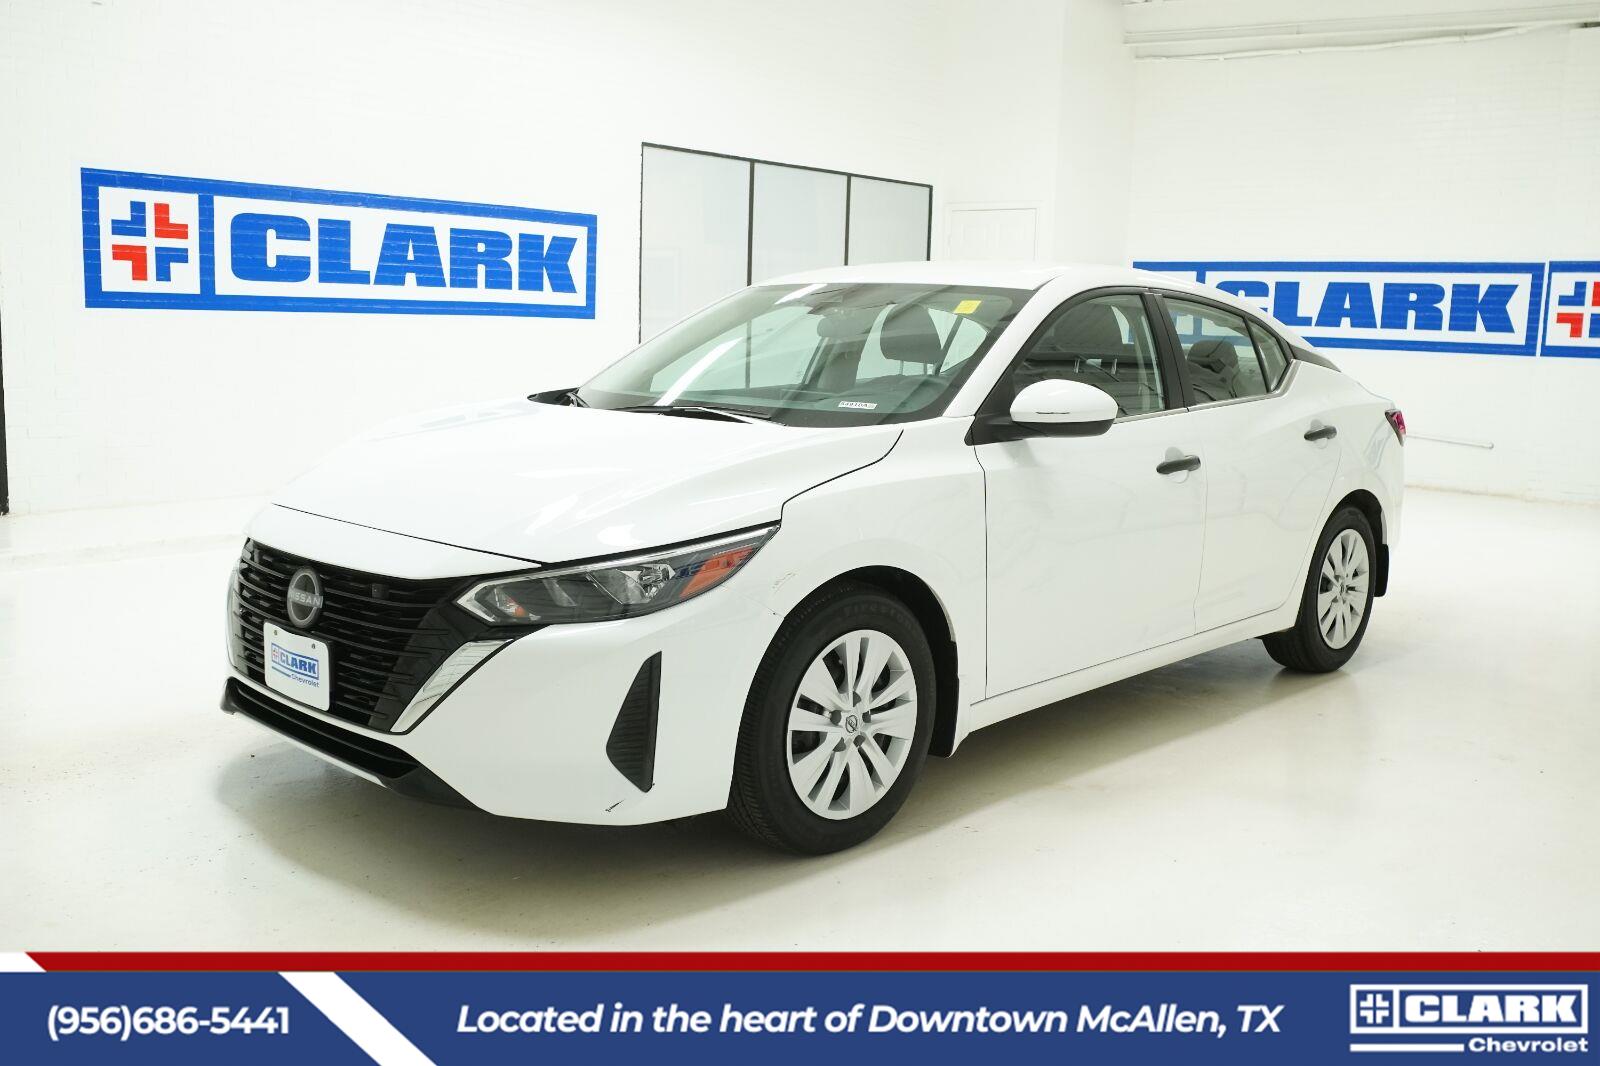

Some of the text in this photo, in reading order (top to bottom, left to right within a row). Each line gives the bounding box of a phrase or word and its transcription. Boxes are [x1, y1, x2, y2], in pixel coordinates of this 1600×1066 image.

[230, 212, 578, 293] CLARK
[288, 590, 321, 607] NISSAN
[279, 652, 317, 675] CLARK
[291, 673, 320, 688] Chevrolet
